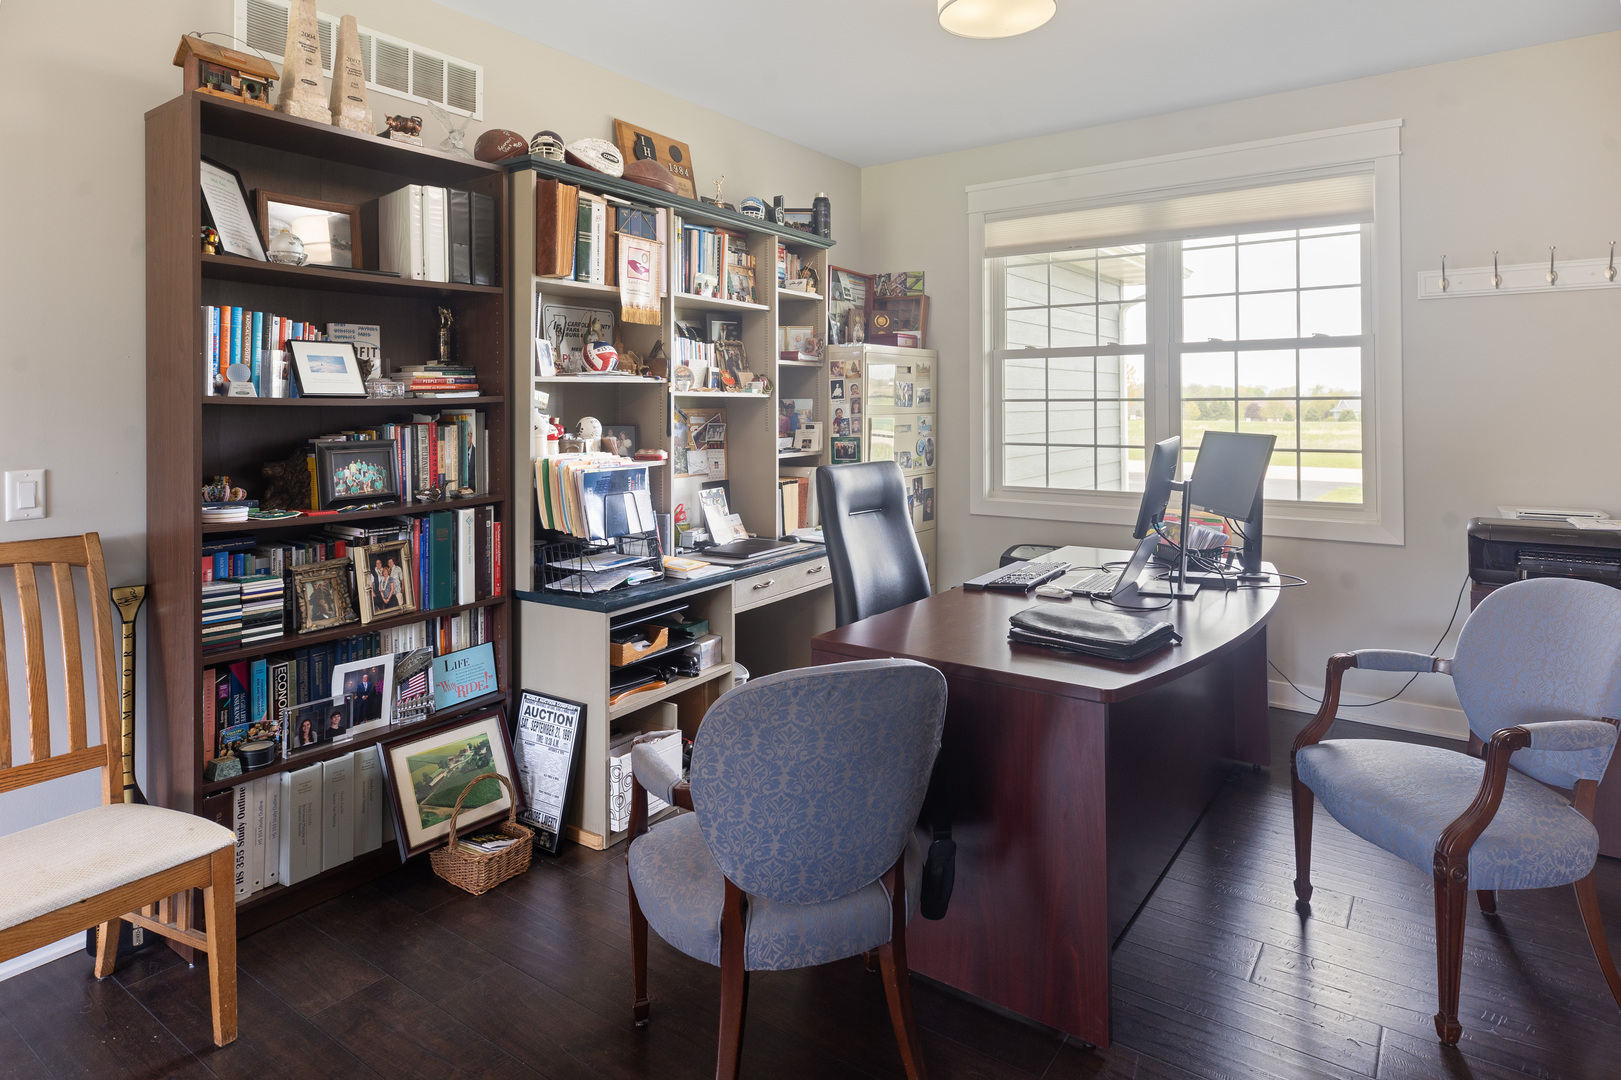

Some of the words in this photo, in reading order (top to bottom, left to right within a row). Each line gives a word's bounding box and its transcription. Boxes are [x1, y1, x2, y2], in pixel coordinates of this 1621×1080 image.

[668, 163, 690, 178] 1984
[524, 705, 574, 727] AUCTION
[530, 720, 555, 736] SEPTEMBER
[236, 786, 246, 820] Outline
[236, 822, 247, 848] Study
[236, 850, 244, 870] 355
[236, 871, 244, 884] HS
